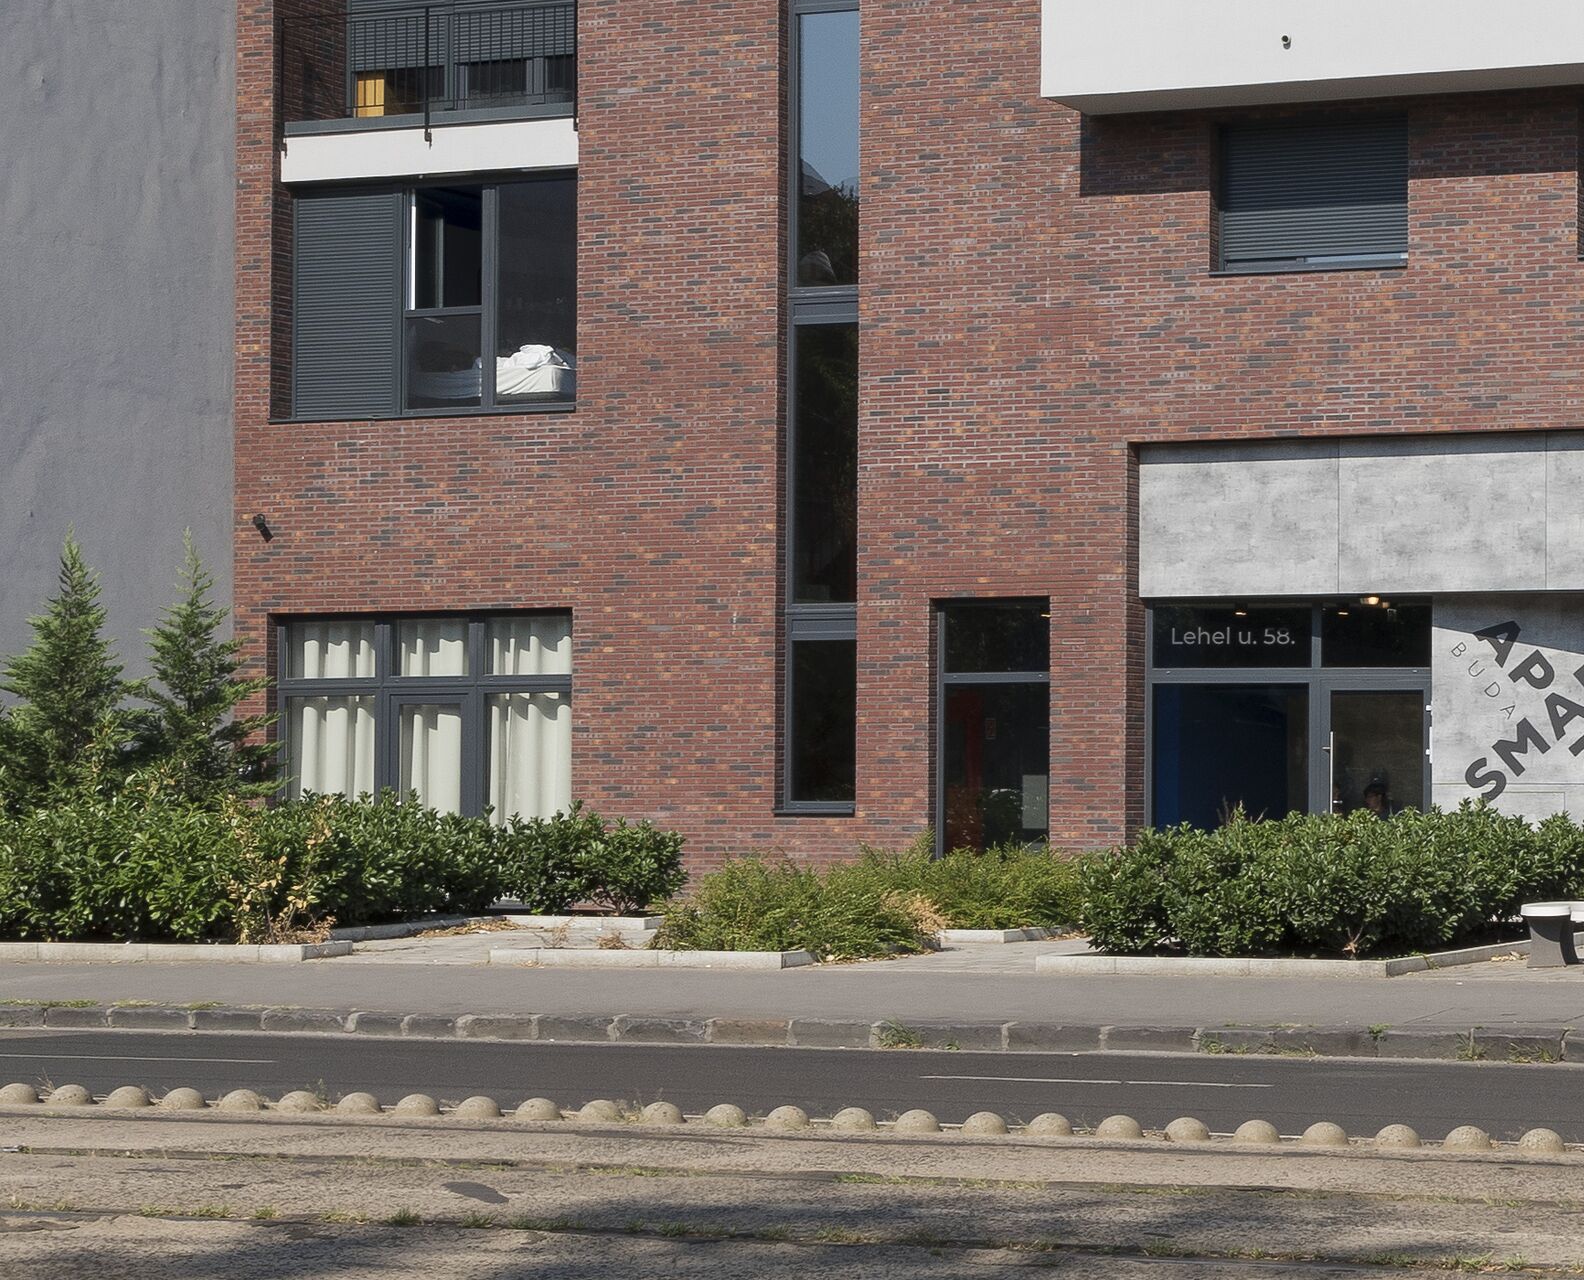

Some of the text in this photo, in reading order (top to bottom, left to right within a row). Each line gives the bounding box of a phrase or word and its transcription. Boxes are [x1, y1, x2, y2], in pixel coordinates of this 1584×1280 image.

[1171, 626, 1296, 645] Lehel u. 58.
[1451, 641, 1517, 720] BUDA
